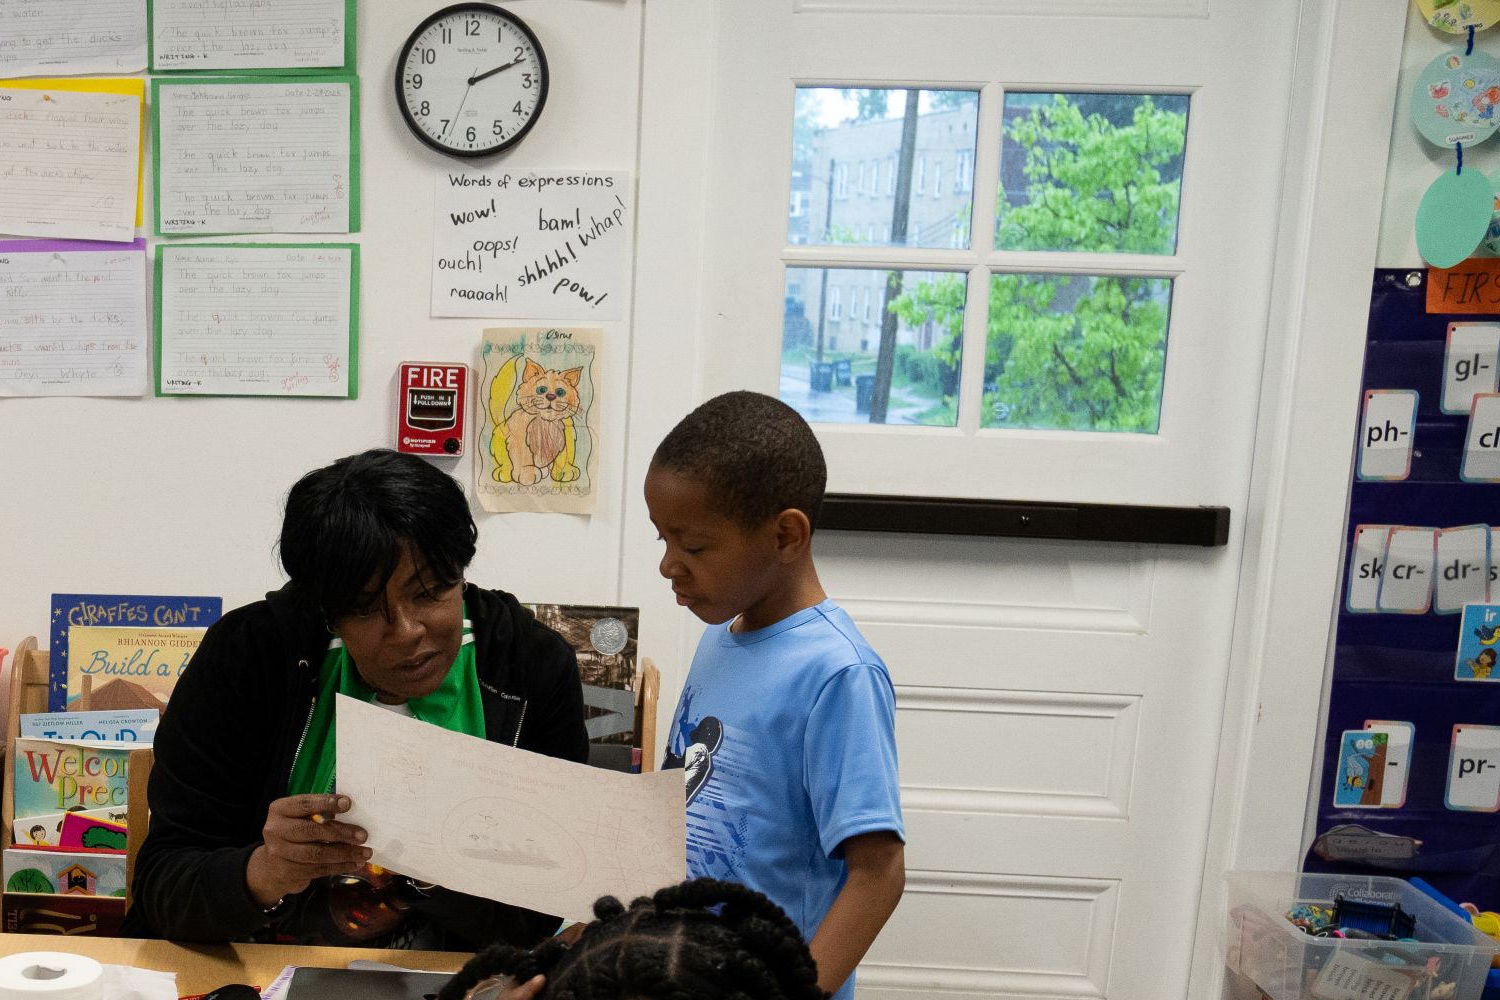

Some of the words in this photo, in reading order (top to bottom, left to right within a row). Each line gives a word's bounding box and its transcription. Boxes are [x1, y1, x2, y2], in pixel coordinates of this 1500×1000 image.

[442, 28, 451, 44] 11
[465, 21, 480, 36] 12
[498, 27, 501, 42] 1
[421, 48, 436, 64] 10
[513, 47, 525, 61] 2
[412, 74, 422, 89] 9
[521, 74, 532, 89] 3
[178, 106, 194, 117] The
[205, 107, 230, 120] quick
[241, 107, 268, 115] brown
[420, 101, 430, 115] 8
[512, 100, 523, 115] 4
[208, 121, 222, 131] the
[231, 121, 250, 134] lazy
[440, 120, 450, 135] 7
[466, 126, 476, 142] 6
[492, 120, 502, 135] 5
[449, 174, 492, 188] Words
[498, 175, 511, 188] of
[518, 174, 614, 192] expressions
[450, 199, 496, 225] wow!
[539, 208, 581, 231] bam!
[578, 195, 626, 246] whap!
[473, 236, 518, 258] oops!
[438, 250, 483, 273] ouch!
[517, 241, 578, 287] shhhh!
[450, 286, 508, 303] raaaah!
[553, 277, 608, 308] pow!
[1455, 354, 1490, 381] gl-
[408, 368, 459, 387] FIRE
[1367, 420, 1408, 447] ph-
[1393, 566, 1425, 580] cr-
[1444, 560, 1480, 580] dr-
[68, 602, 148, 626] GIRAFFES
[153, 603, 200, 626] CAN'T
[118, 639, 166, 647] RHIANNON
[80, 649, 159, 676] Build
[157, 663, 170, 676] a
[1458, 755, 1496, 777] pr-
